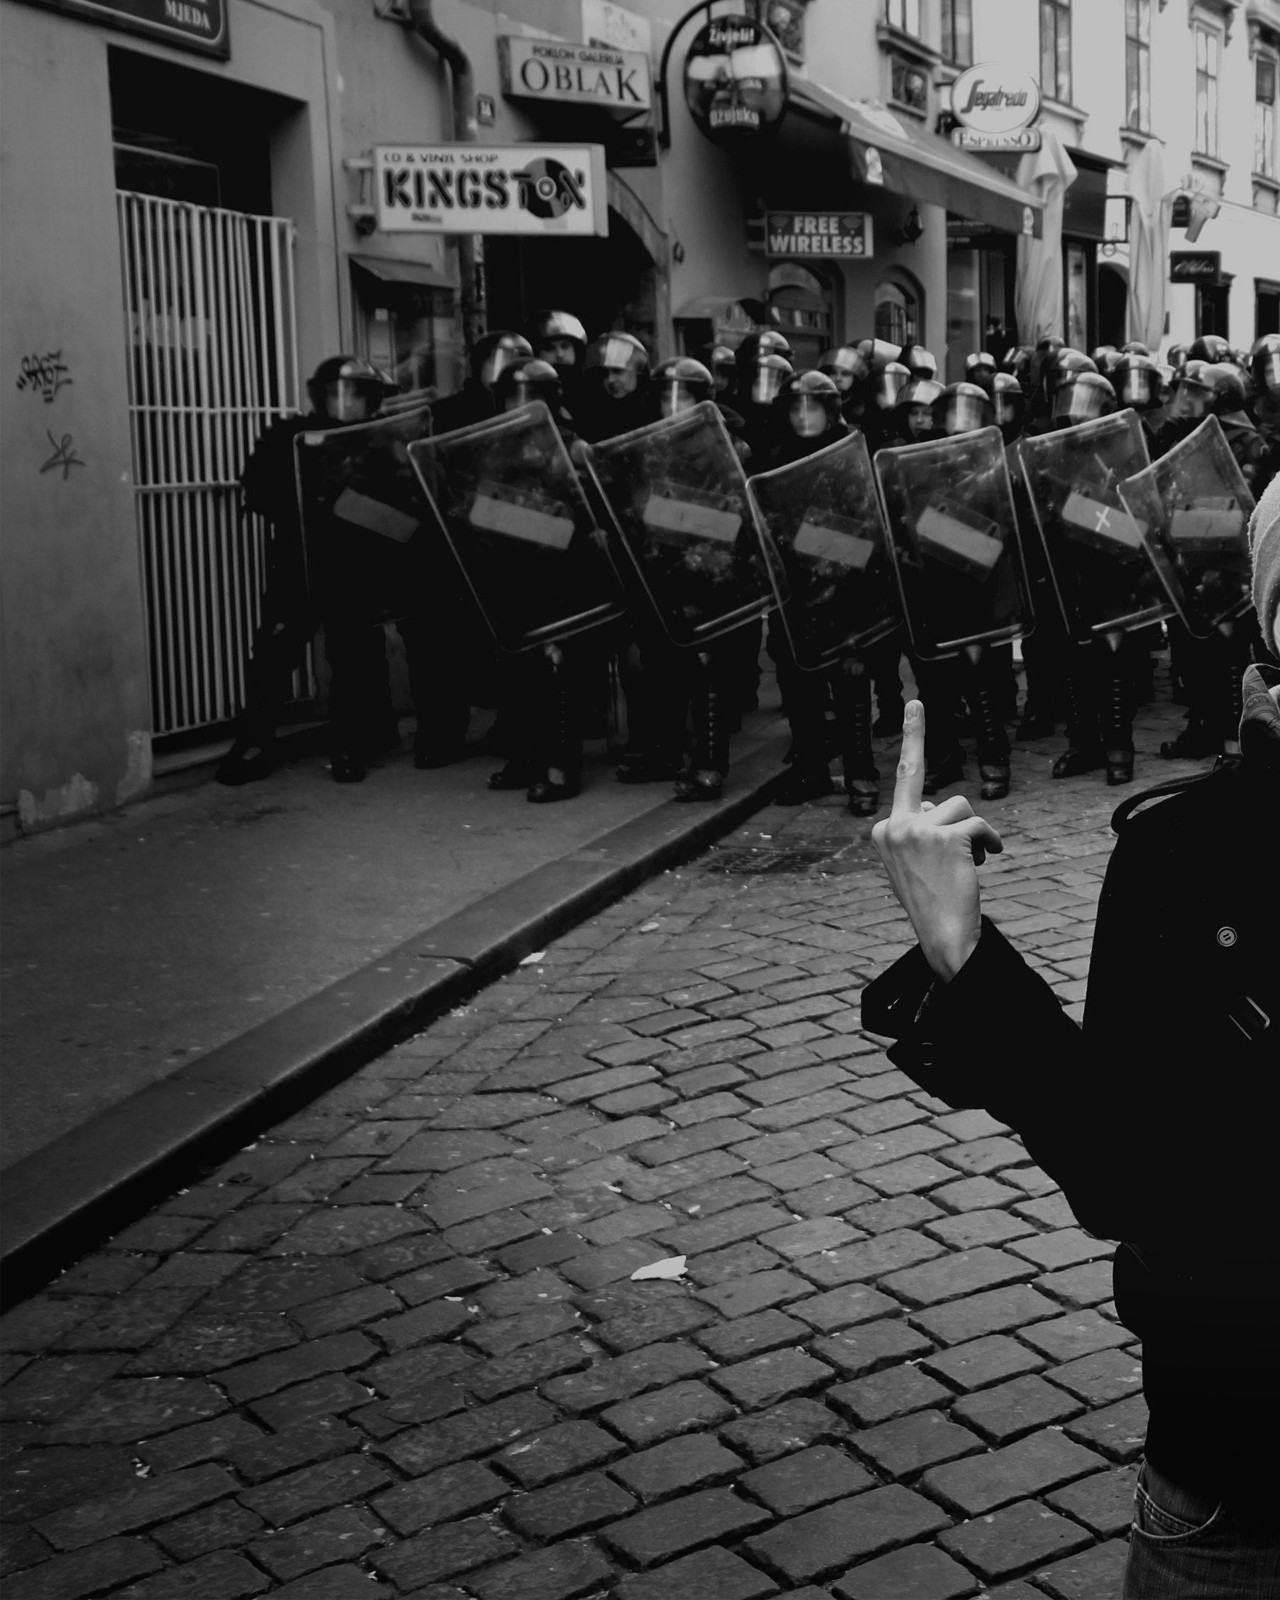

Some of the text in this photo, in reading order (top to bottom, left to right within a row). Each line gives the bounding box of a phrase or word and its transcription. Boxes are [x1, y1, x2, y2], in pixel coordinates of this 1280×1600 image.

[531, 45, 623, 65] POKLON GALERIJA
[520, 57, 641, 102] OBLAK
[960, 79, 1028, 114] Segafredo
[406, 153, 415, 163] &
[460, 153, 499, 164] SHOP
[382, 167, 586, 209] KINGSTON
[793, 216, 839, 234] FREE
[769, 234, 863, 254] WIRELESS
